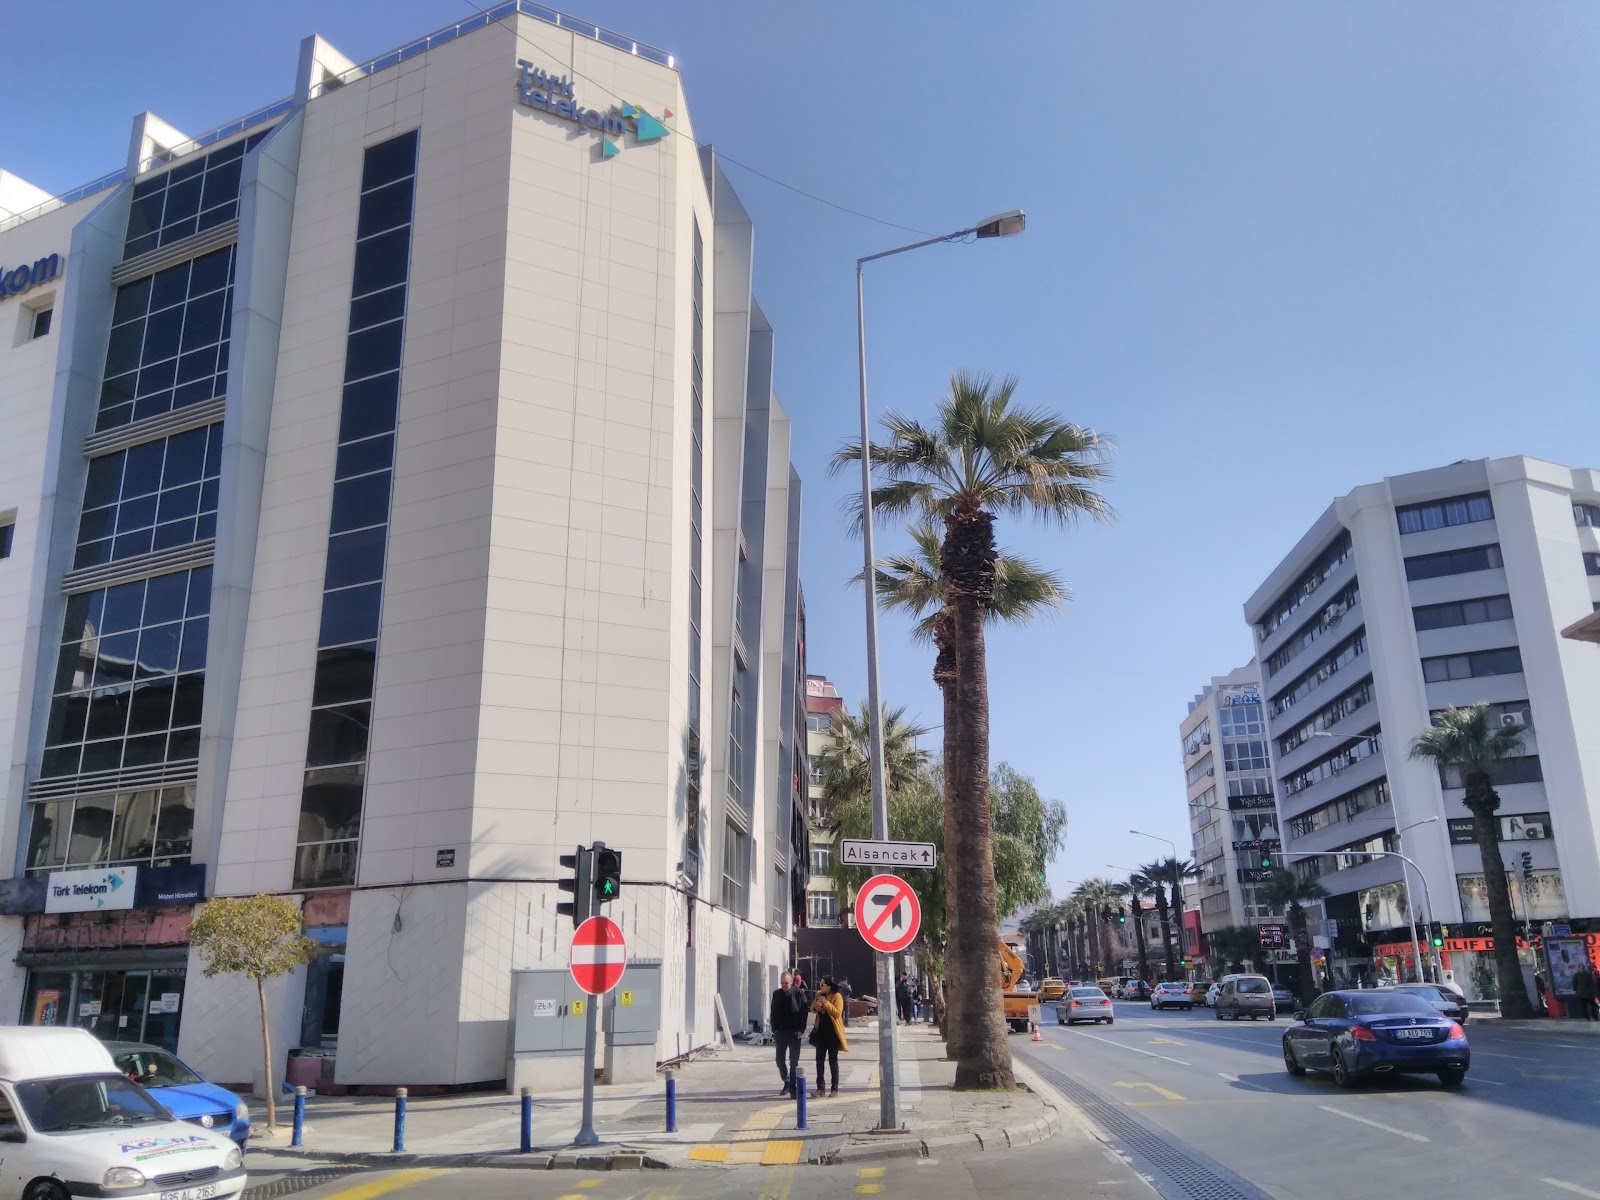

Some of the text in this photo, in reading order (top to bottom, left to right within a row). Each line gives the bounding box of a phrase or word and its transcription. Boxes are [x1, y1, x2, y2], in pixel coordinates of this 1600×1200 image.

[518, 58, 575, 99] Türk
[516, 79, 626, 136] Telekom
[847, 847, 918, 861] Alsancak
[53, 884, 107, 896] Türk Telekom
[174, 891, 198, 900] Hizmetleri
[1442, 940, 1479, 950] ILIF
[181, 1190, 194, 1200] AL
[196, 1185, 215, 1199] 2163
